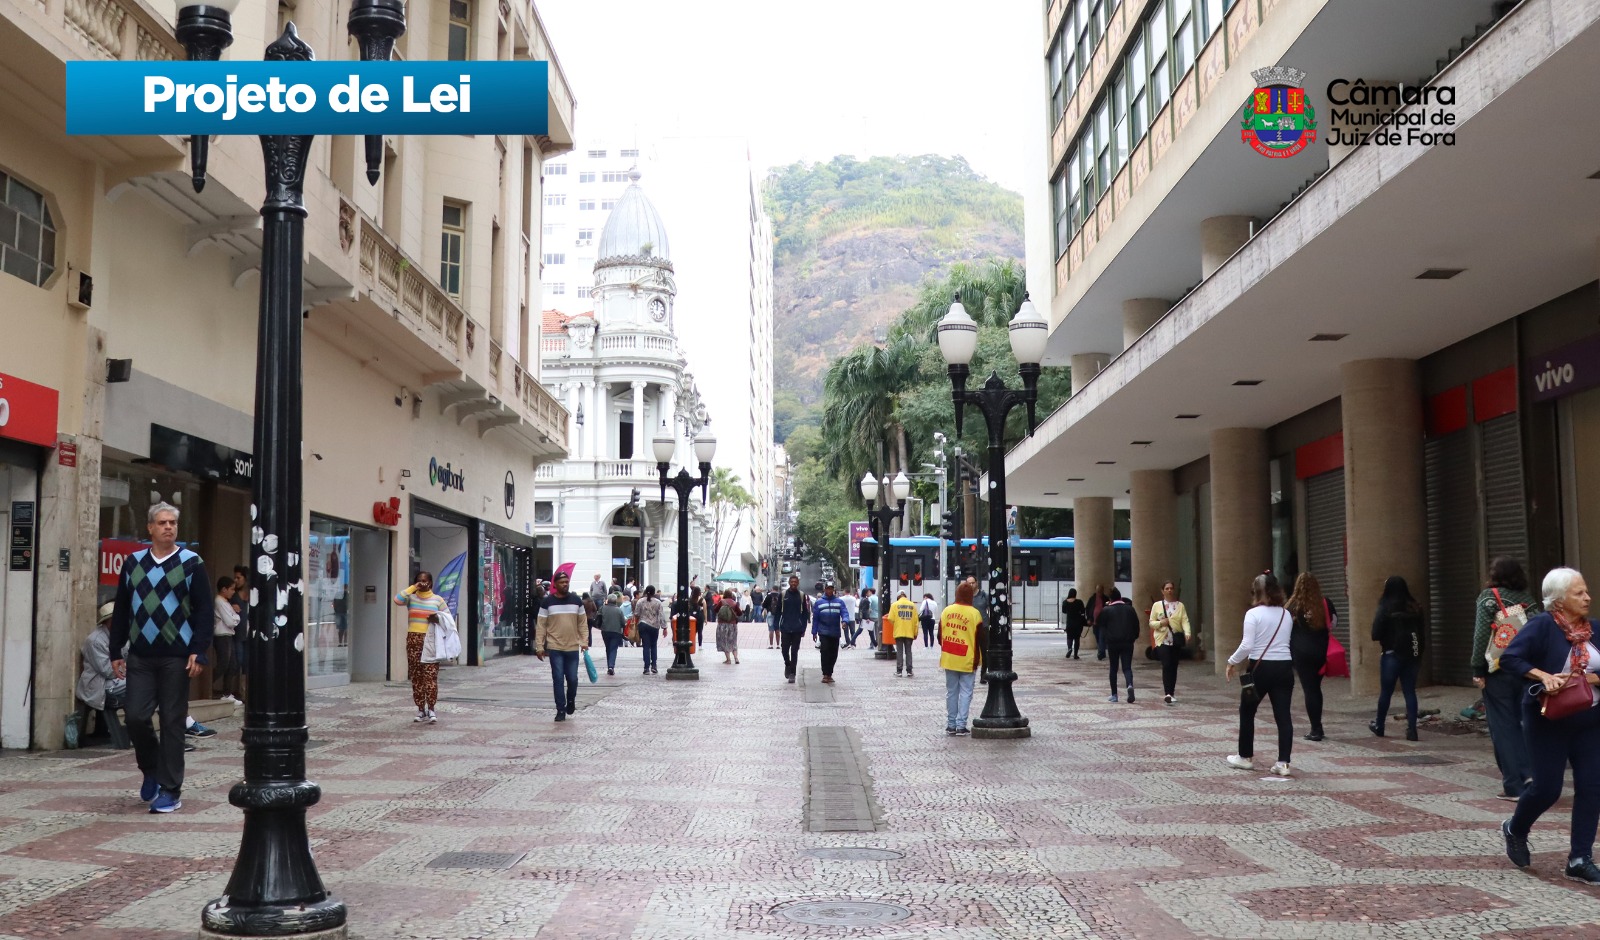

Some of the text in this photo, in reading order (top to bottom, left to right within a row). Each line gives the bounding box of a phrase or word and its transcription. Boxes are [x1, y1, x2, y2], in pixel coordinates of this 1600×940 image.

[1535, 361, 1574, 392] vivo
[437, 462, 465, 492] agibank
[102, 552, 128, 575] LIQ
[946, 622, 967, 632] OURO
[1411, 632, 1419, 657] adidas
